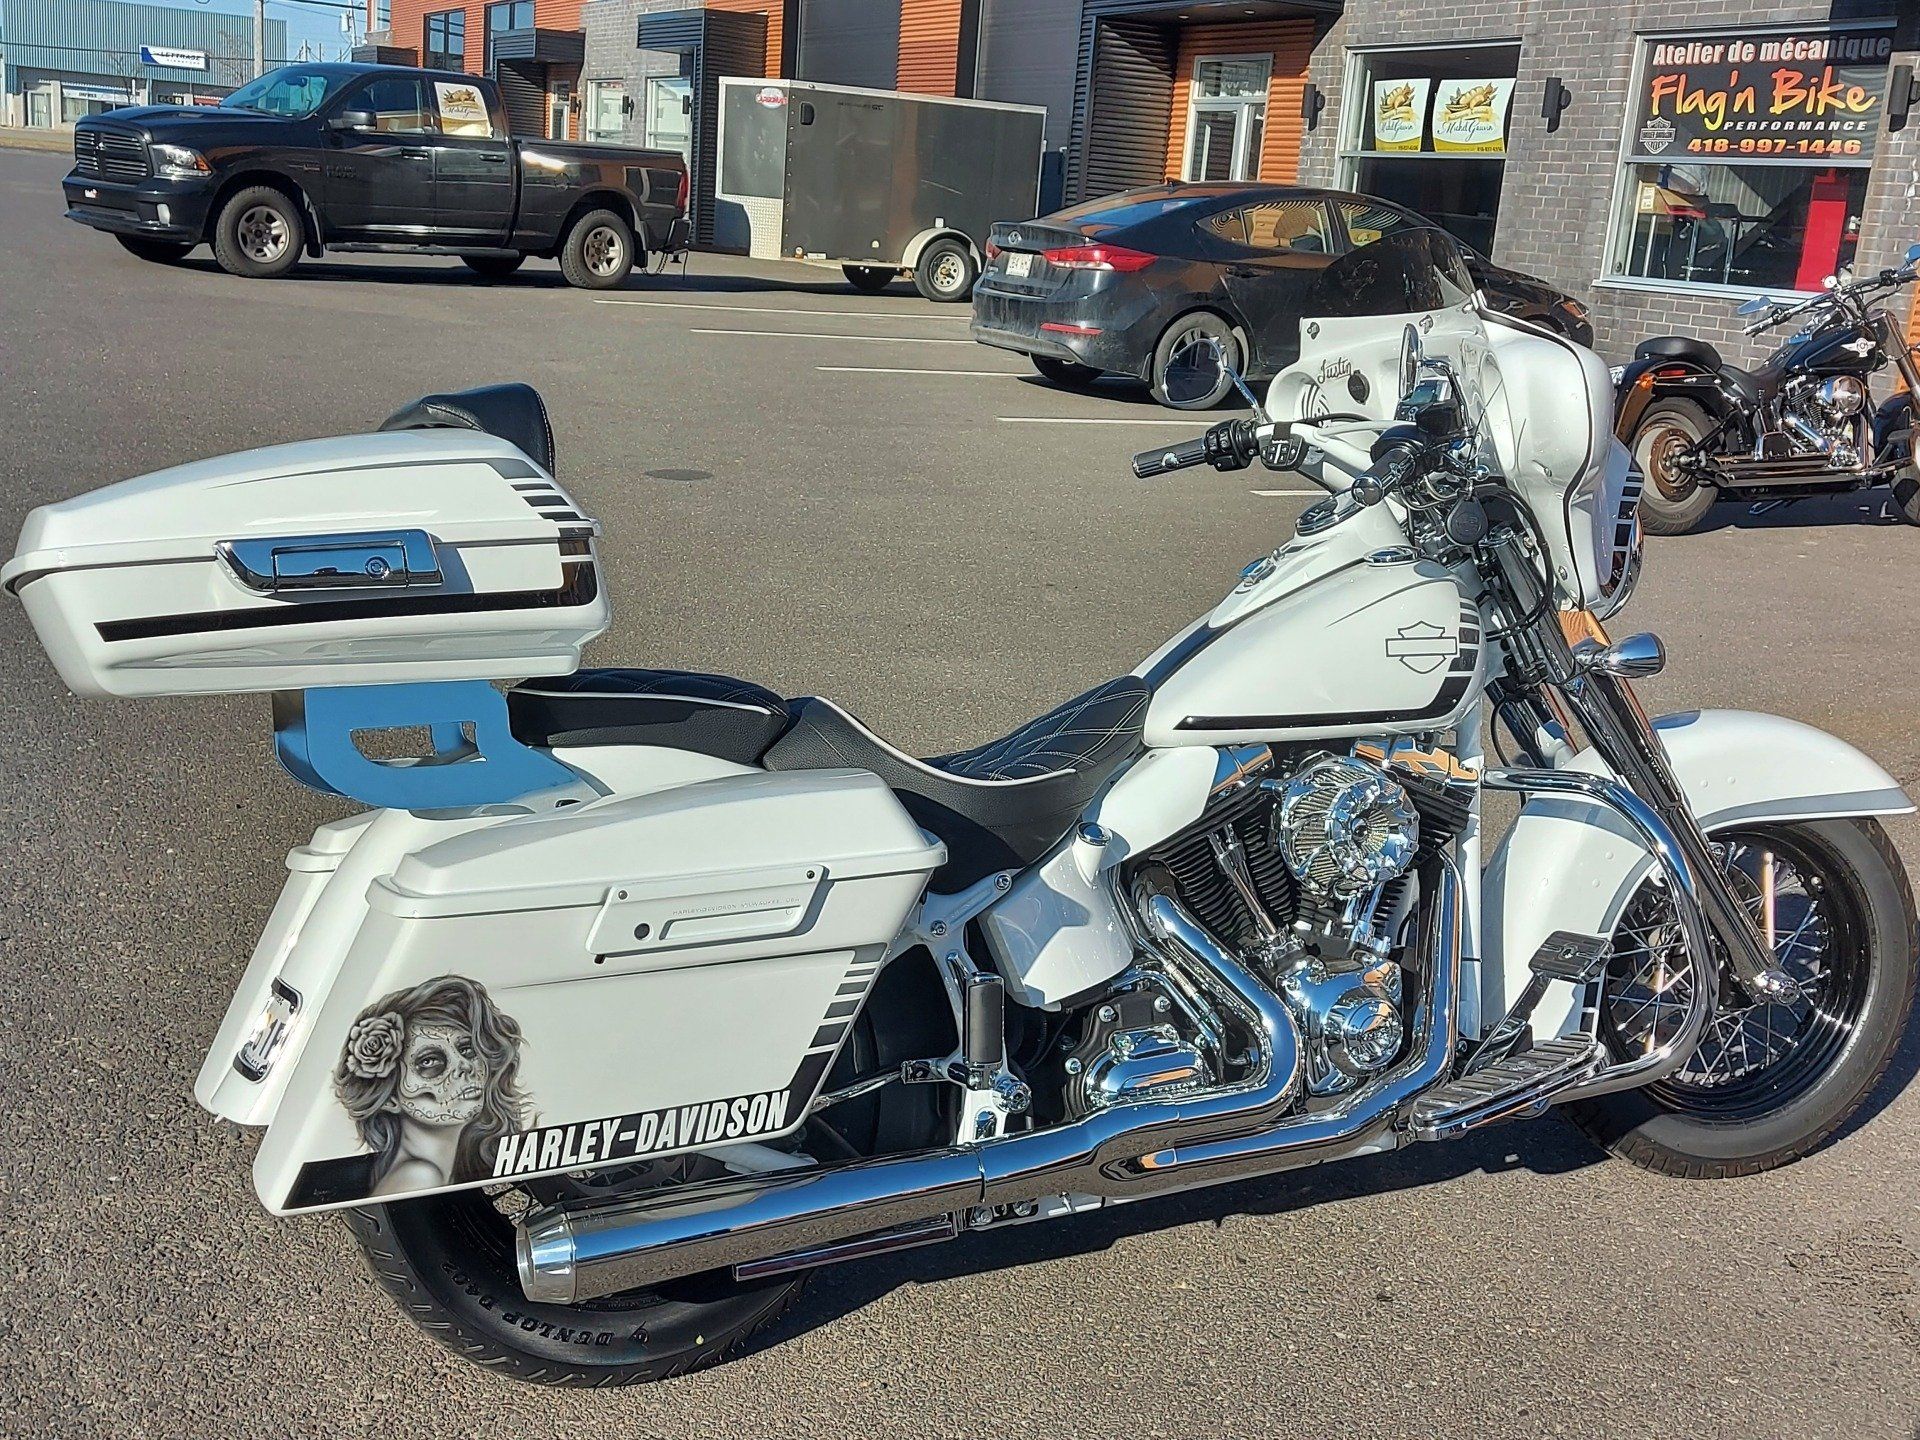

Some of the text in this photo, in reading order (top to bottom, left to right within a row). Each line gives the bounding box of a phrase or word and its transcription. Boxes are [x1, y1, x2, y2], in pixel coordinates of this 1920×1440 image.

[1652, 37, 1891, 66] Atelier de mécanique
[1650, 65, 1877, 131] Flag'n Bike
[1723, 120, 1868, 131] PERFORMANCE
[1687, 138, 1862, 155] 418-997-1446
[1317, 356, 1353, 384] Justin
[492, 1090, 791, 1178] HARLEY-DAVIDSON
[502, 1311, 615, 1346] DUNLOP
